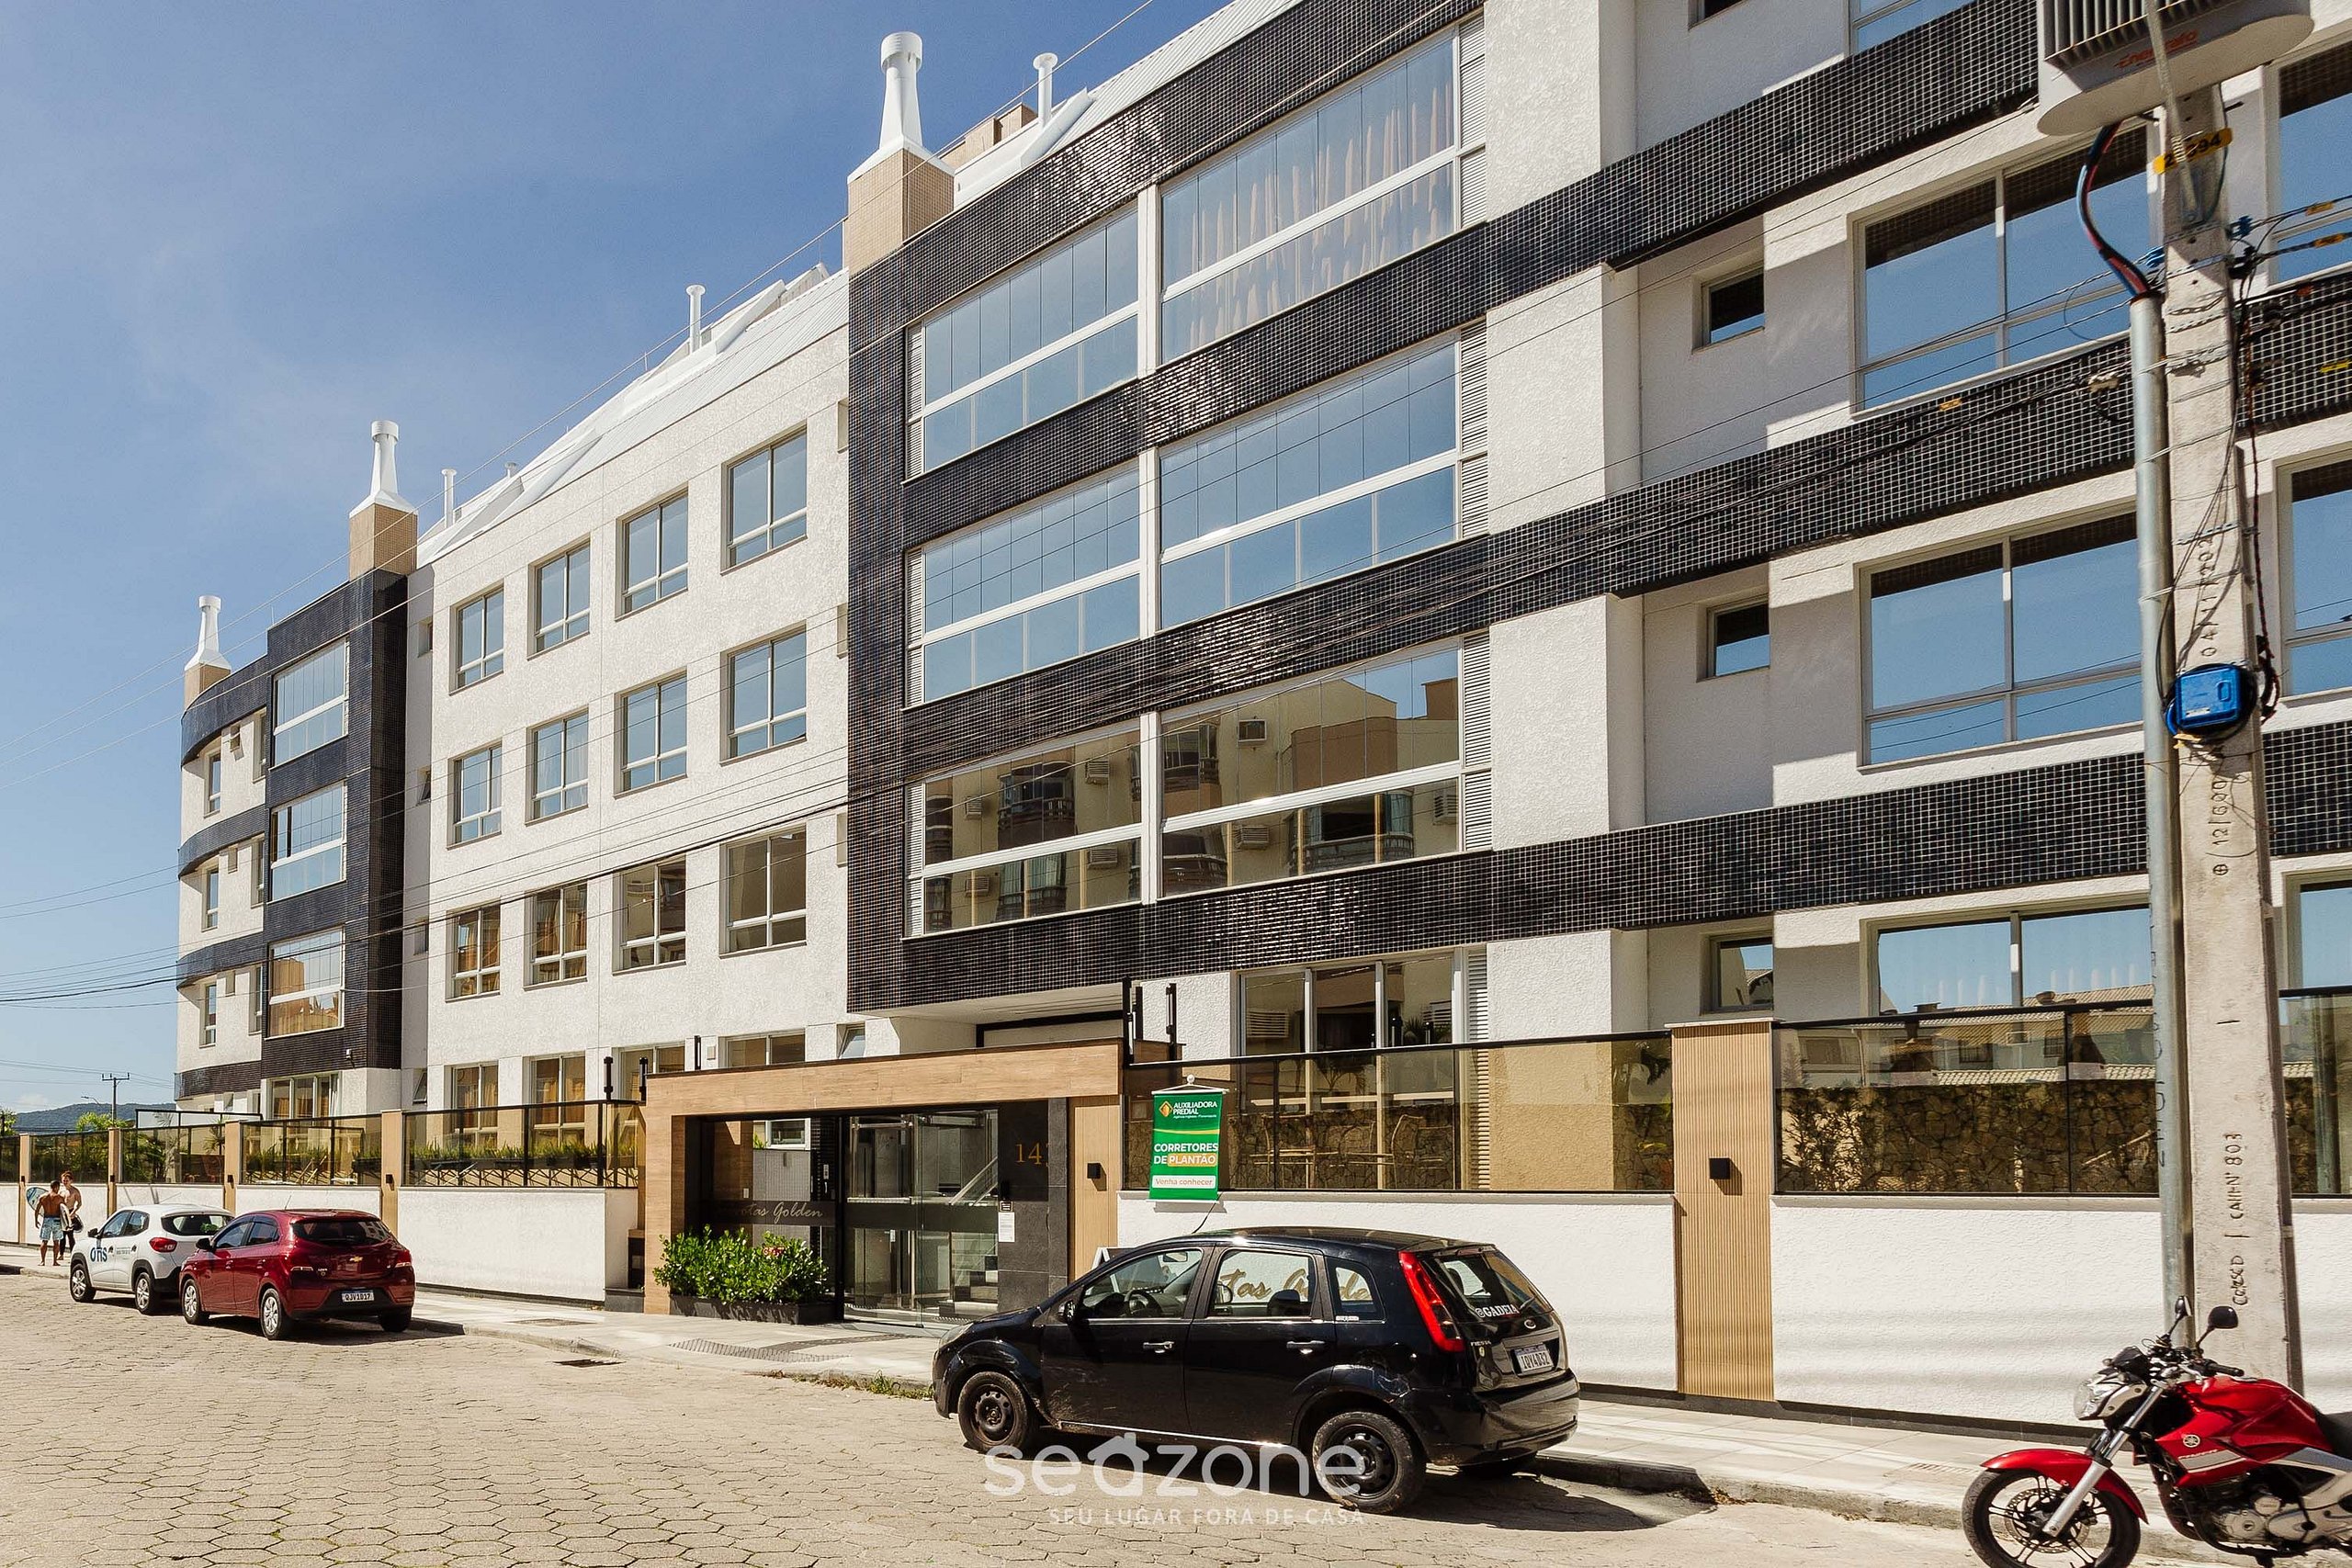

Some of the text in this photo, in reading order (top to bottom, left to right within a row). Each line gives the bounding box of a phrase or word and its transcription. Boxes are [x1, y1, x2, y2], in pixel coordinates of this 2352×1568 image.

[1154, 1143, 1218, 1153] CORRETORES
[1015, 1142, 1050, 1167] 14
[1154, 1154, 1216, 1165] DE PLANTÃO
[1179, 1178, 1213, 1186] conhecer
[773, 1201, 823, 1224] Golden
